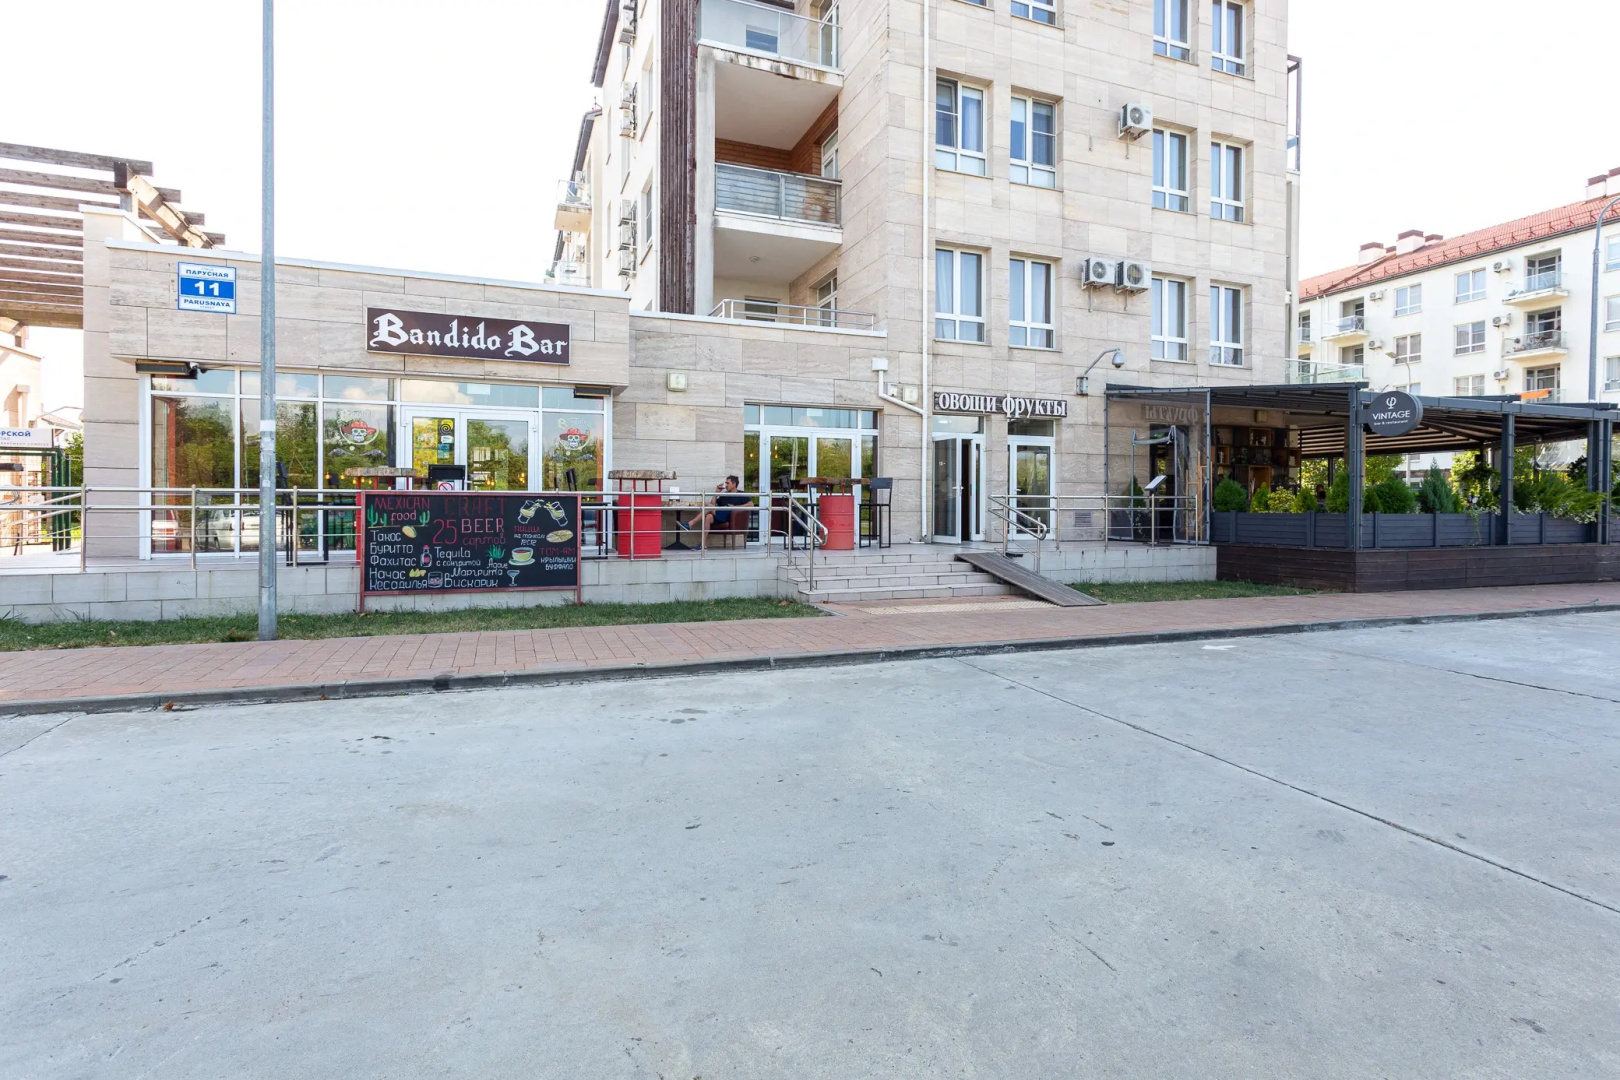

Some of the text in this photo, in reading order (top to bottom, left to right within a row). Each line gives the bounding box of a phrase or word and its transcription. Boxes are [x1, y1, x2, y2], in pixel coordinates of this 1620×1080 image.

[185, 269, 229, 278] ПАРУСНАЯ
[194, 280, 220, 297] 11
[183, 298, 231, 308] PARUSNAYA
[369, 312, 568, 357] Bandido Bar
[1372, 410, 1411, 420] VINTAGE
[374, 497, 431, 511] MEXICAN
[444, 496, 506, 516] CRAFT
[390, 510, 417, 525] food
[432, 518, 457, 545] 25
[461, 518, 505, 534] BEER
[369, 530, 401, 542] Такос
[462, 533, 506, 549] сортов
[369, 542, 414, 555] Буритто
[434, 546, 471, 561] Tequila
[370, 555, 417, 567] Фахитас
[444, 572, 499, 588] Вискарик
